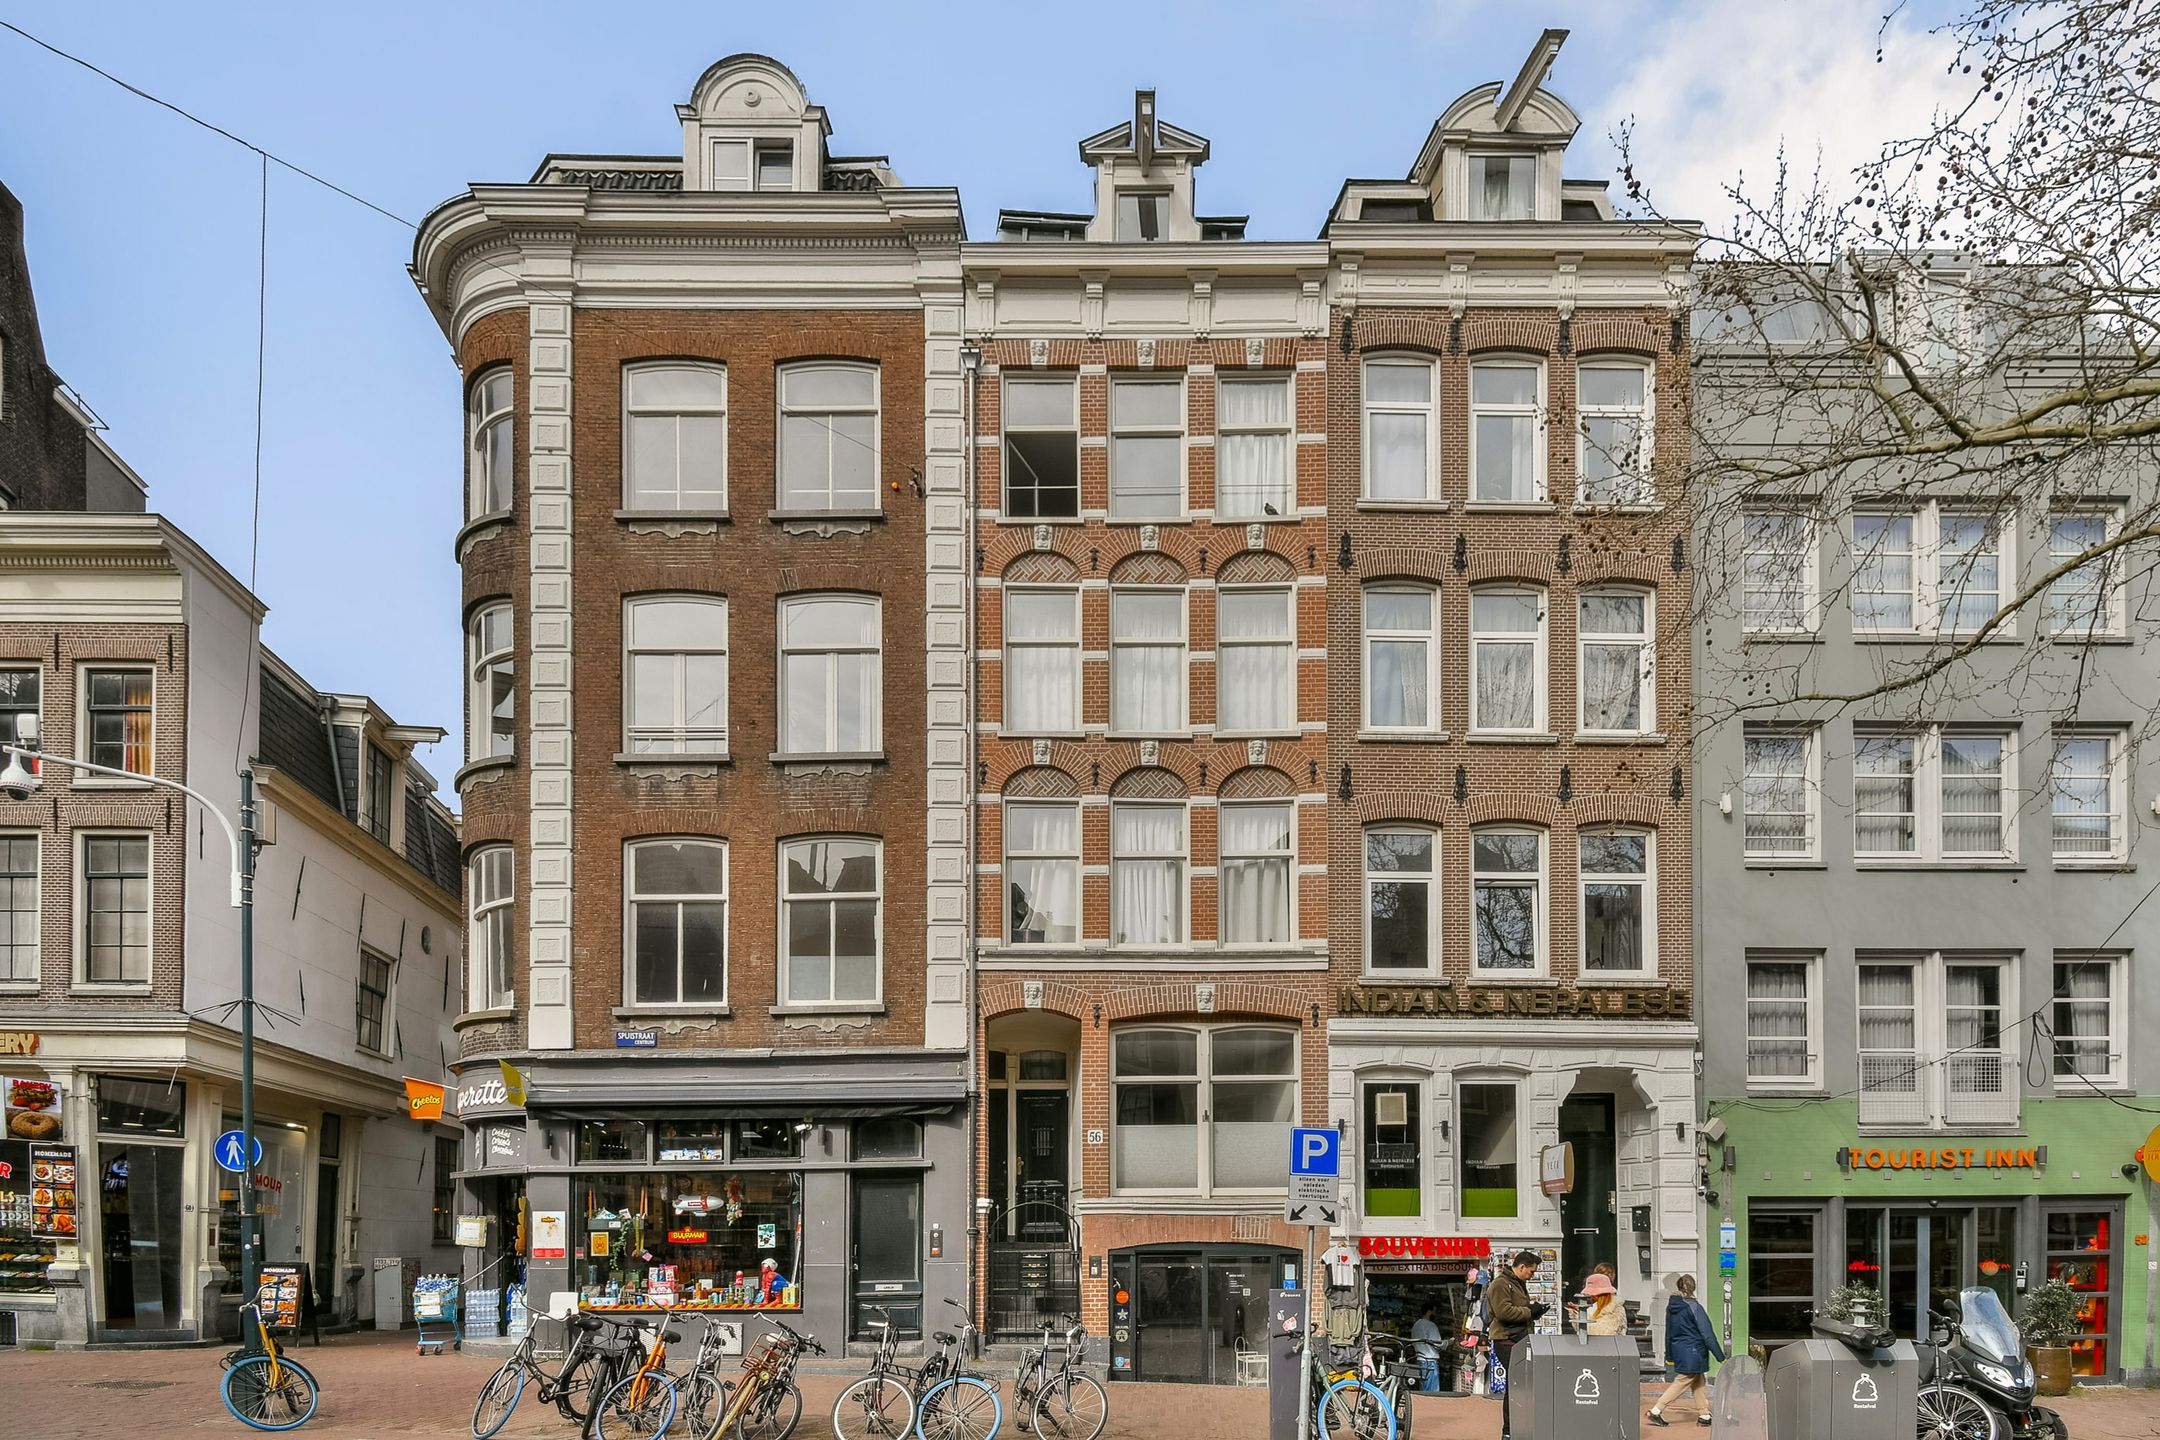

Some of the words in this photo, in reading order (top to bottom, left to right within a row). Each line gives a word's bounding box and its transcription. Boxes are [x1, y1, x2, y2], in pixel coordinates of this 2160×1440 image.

[1336, 988, 1458, 1012] INDIAN
[1468, 988, 1494, 1013] &
[1503, 988, 1691, 1014] NEPALESE
[412, 1096, 440, 1109] Cheetos
[1089, 1131, 1102, 1143] 56
[34, 1150, 72, 1158] HOMEMADE
[1302, 1134, 1328, 1169] P
[1850, 1148, 1975, 1169] TOURIST
[1985, 1149, 2035, 1168] INN
[672, 1231, 705, 1239] BUURMAN
[1359, 1236, 1491, 1257] SOUVENIRS
[1398, 1263, 1429, 1272] EXTRA
[1432, 1263, 1475, 1271] DISCOUN
